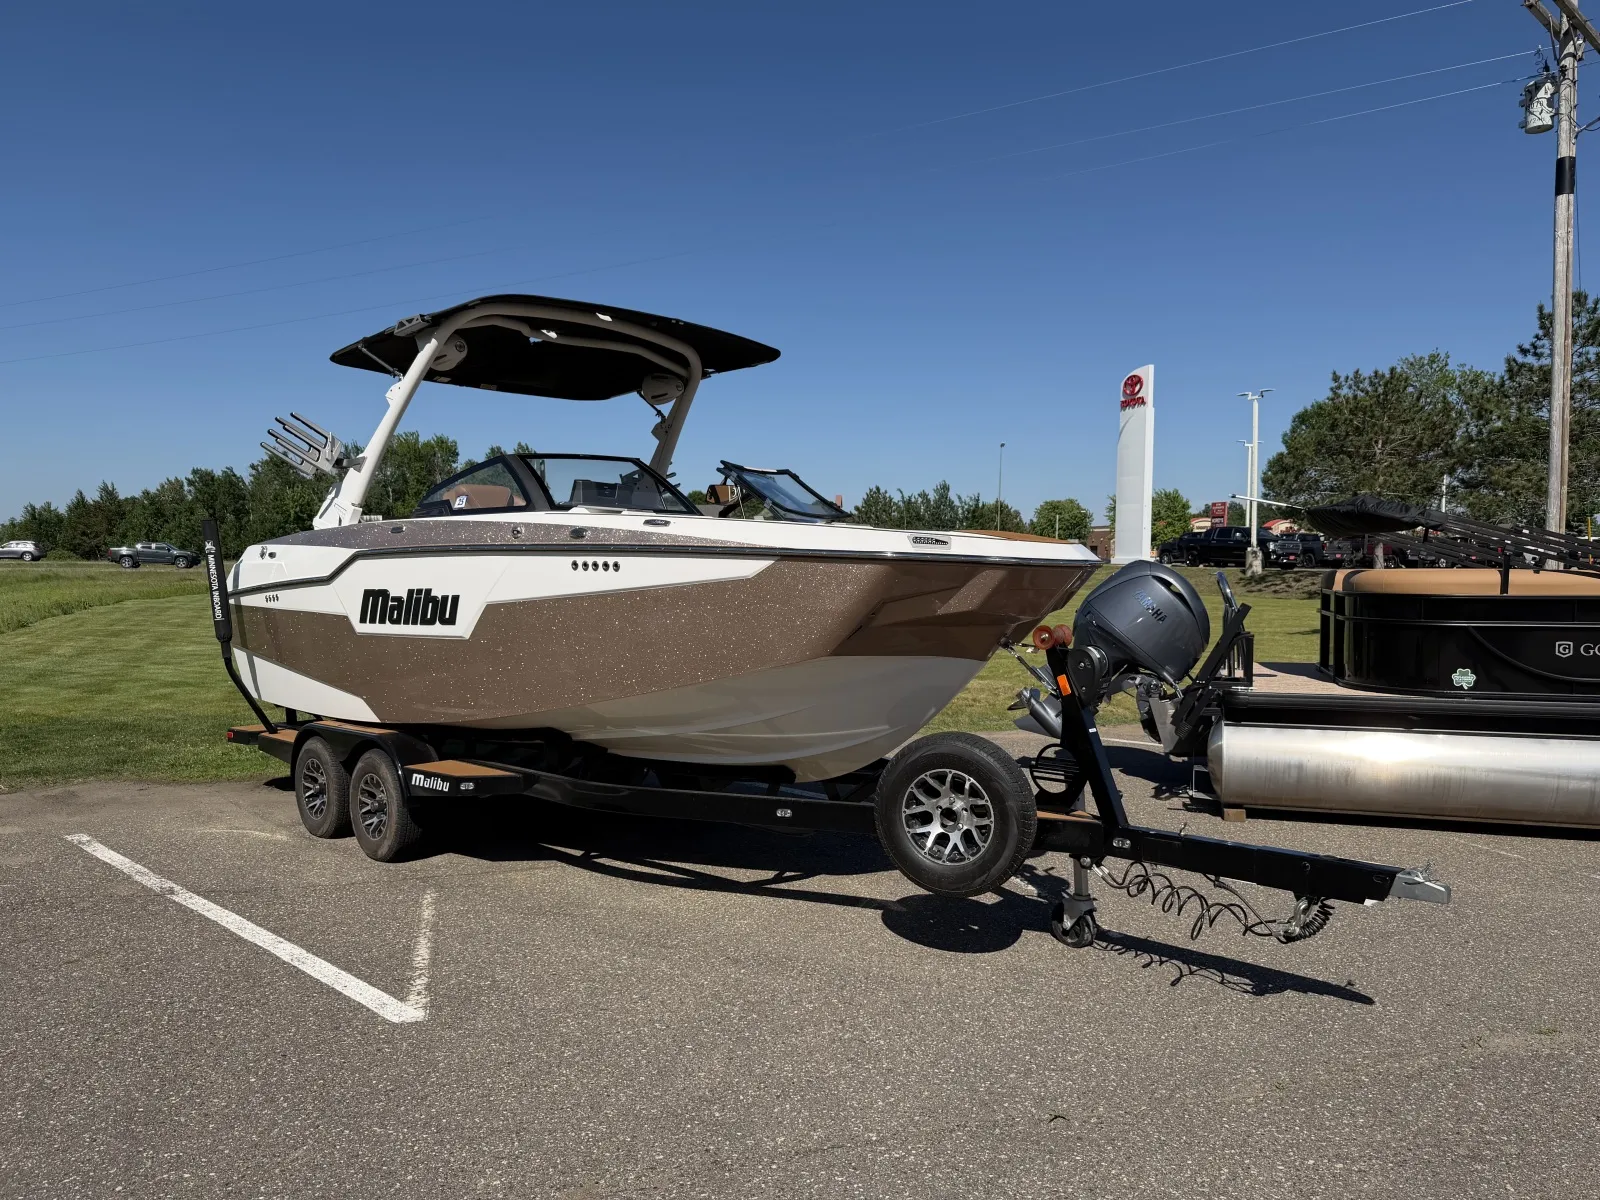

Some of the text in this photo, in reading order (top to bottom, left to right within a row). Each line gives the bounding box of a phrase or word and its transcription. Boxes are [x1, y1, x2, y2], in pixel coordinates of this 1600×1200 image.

[1120, 396, 1145, 410] TOYOTA
[207, 554, 223, 618] MINNESOTA INBOARD
[359, 588, 460, 626] Malibu
[1132, 589, 1168, 624] YAMAHA
[411, 773, 450, 792] Malibu
